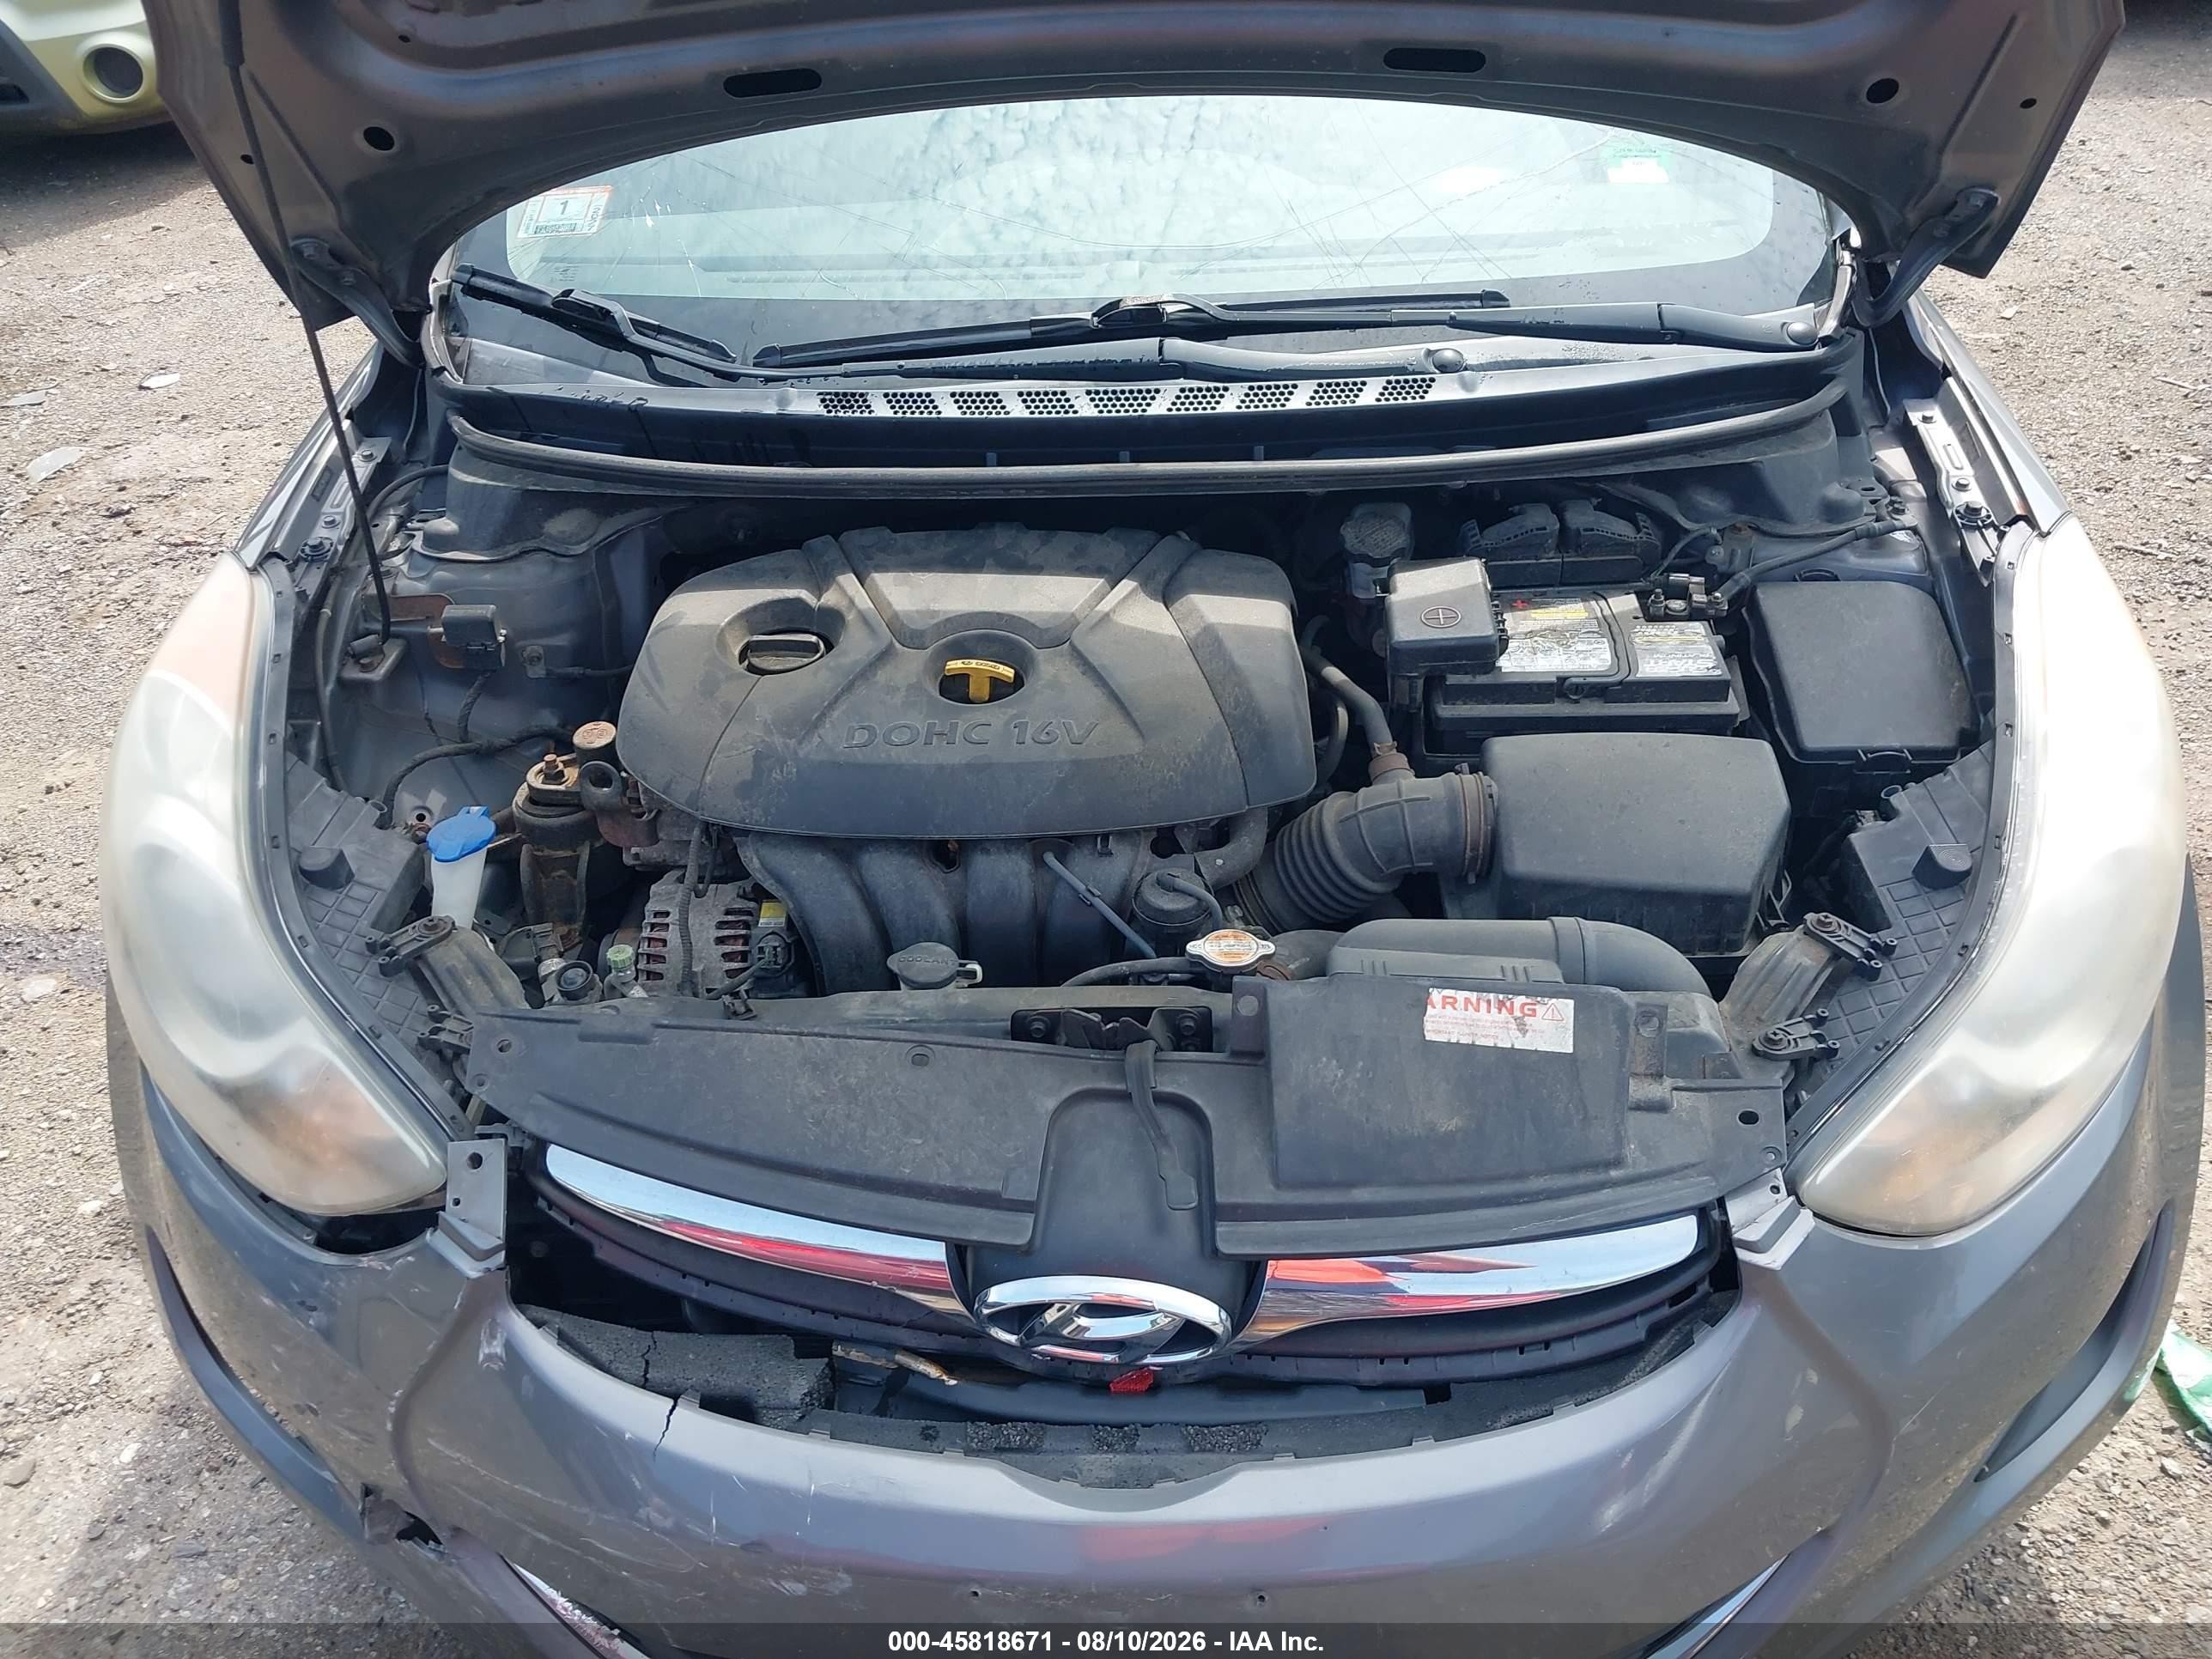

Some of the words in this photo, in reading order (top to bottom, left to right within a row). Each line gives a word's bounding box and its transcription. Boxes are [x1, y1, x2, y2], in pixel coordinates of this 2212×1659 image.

[560, 200, 569, 216] 1
[842, 720, 994, 749] DOHC
[1013, 720, 1100, 745] 16V
[1425, 994, 1538, 1018] ARNING
